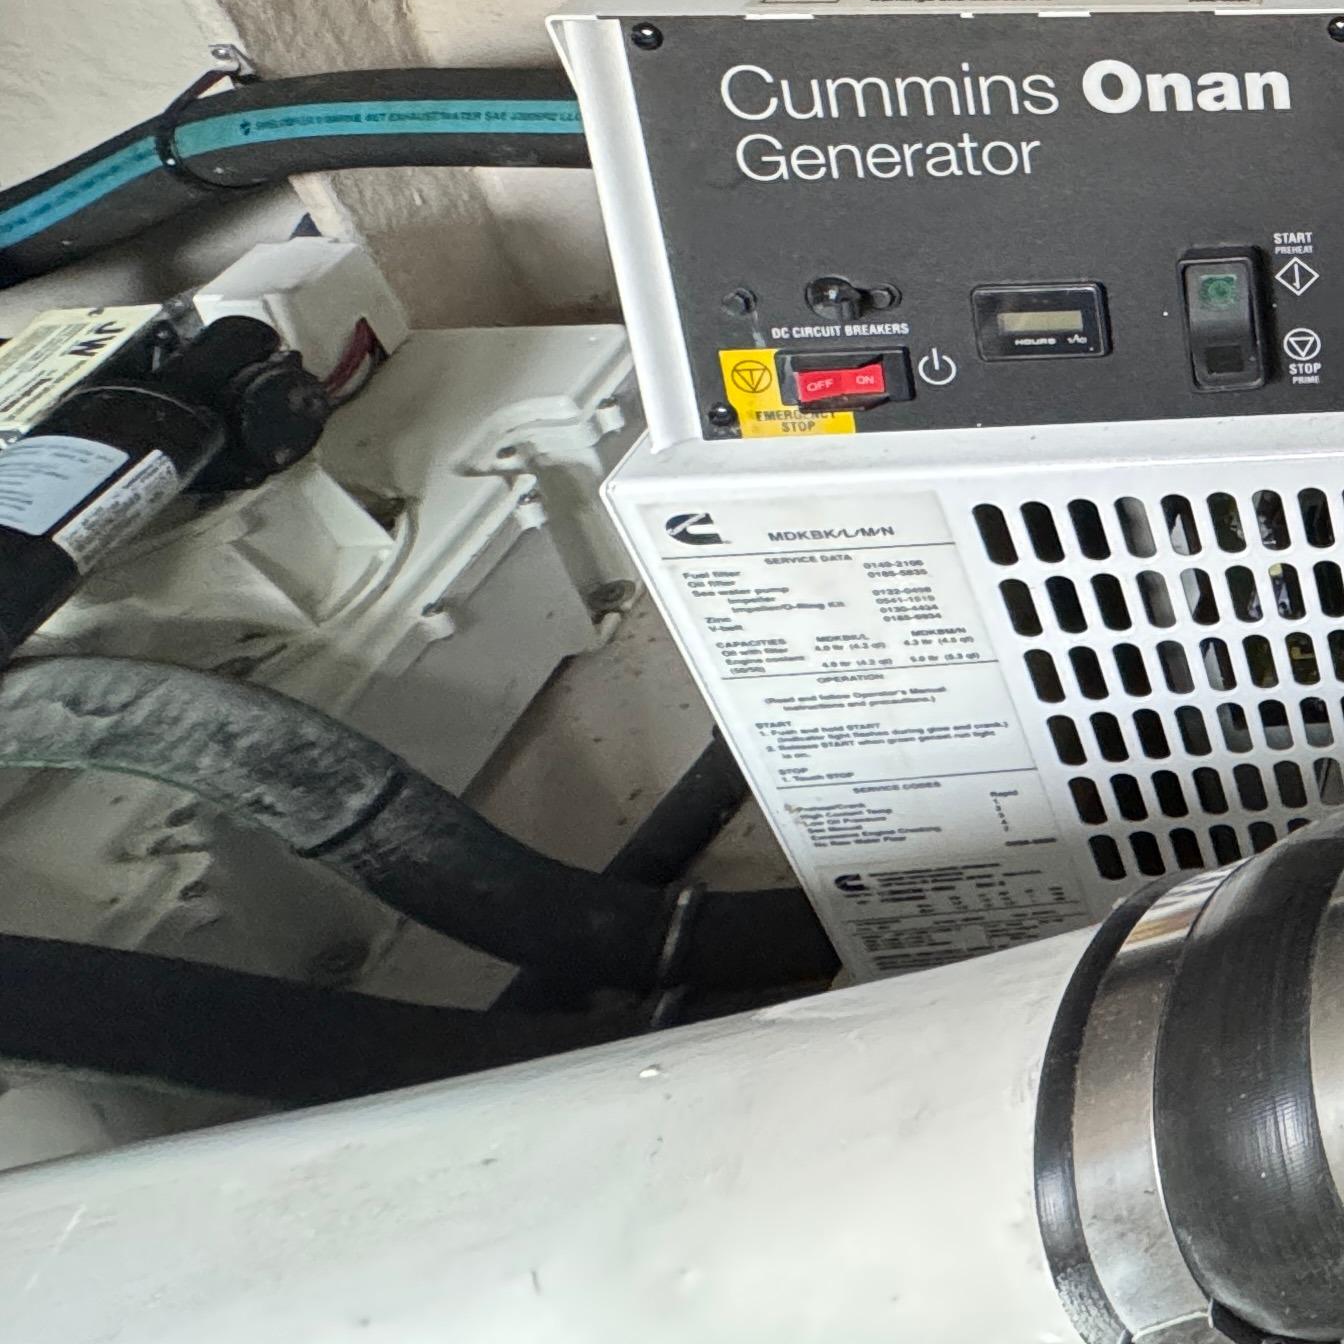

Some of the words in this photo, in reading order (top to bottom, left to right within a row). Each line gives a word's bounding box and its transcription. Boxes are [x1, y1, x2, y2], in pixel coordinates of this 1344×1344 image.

[720, 62, 1060, 121] Cummins
[1081, 58, 1292, 114] Onan
[735, 132, 1041, 183] Generator
[1273, 231, 1313, 245] START
[1274, 245, 1314, 255] PREHEAT
[771, 327, 790, 340] DC
[792, 325, 842, 339] CIRCUIT
[844, 322, 910, 337] BREAKERS
[1014, 337, 1057, 346] HOURS
[1289, 362, 1323, 375] STOP
[805, 377, 834, 393] OFF
[855, 374, 876, 385] ON
[1292, 375, 1321, 385] PRIME
[781, 420, 816, 433] STOP
[767, 525, 896, 542] MDKBK/L/M/N
[820, 553, 853, 564] DATA
